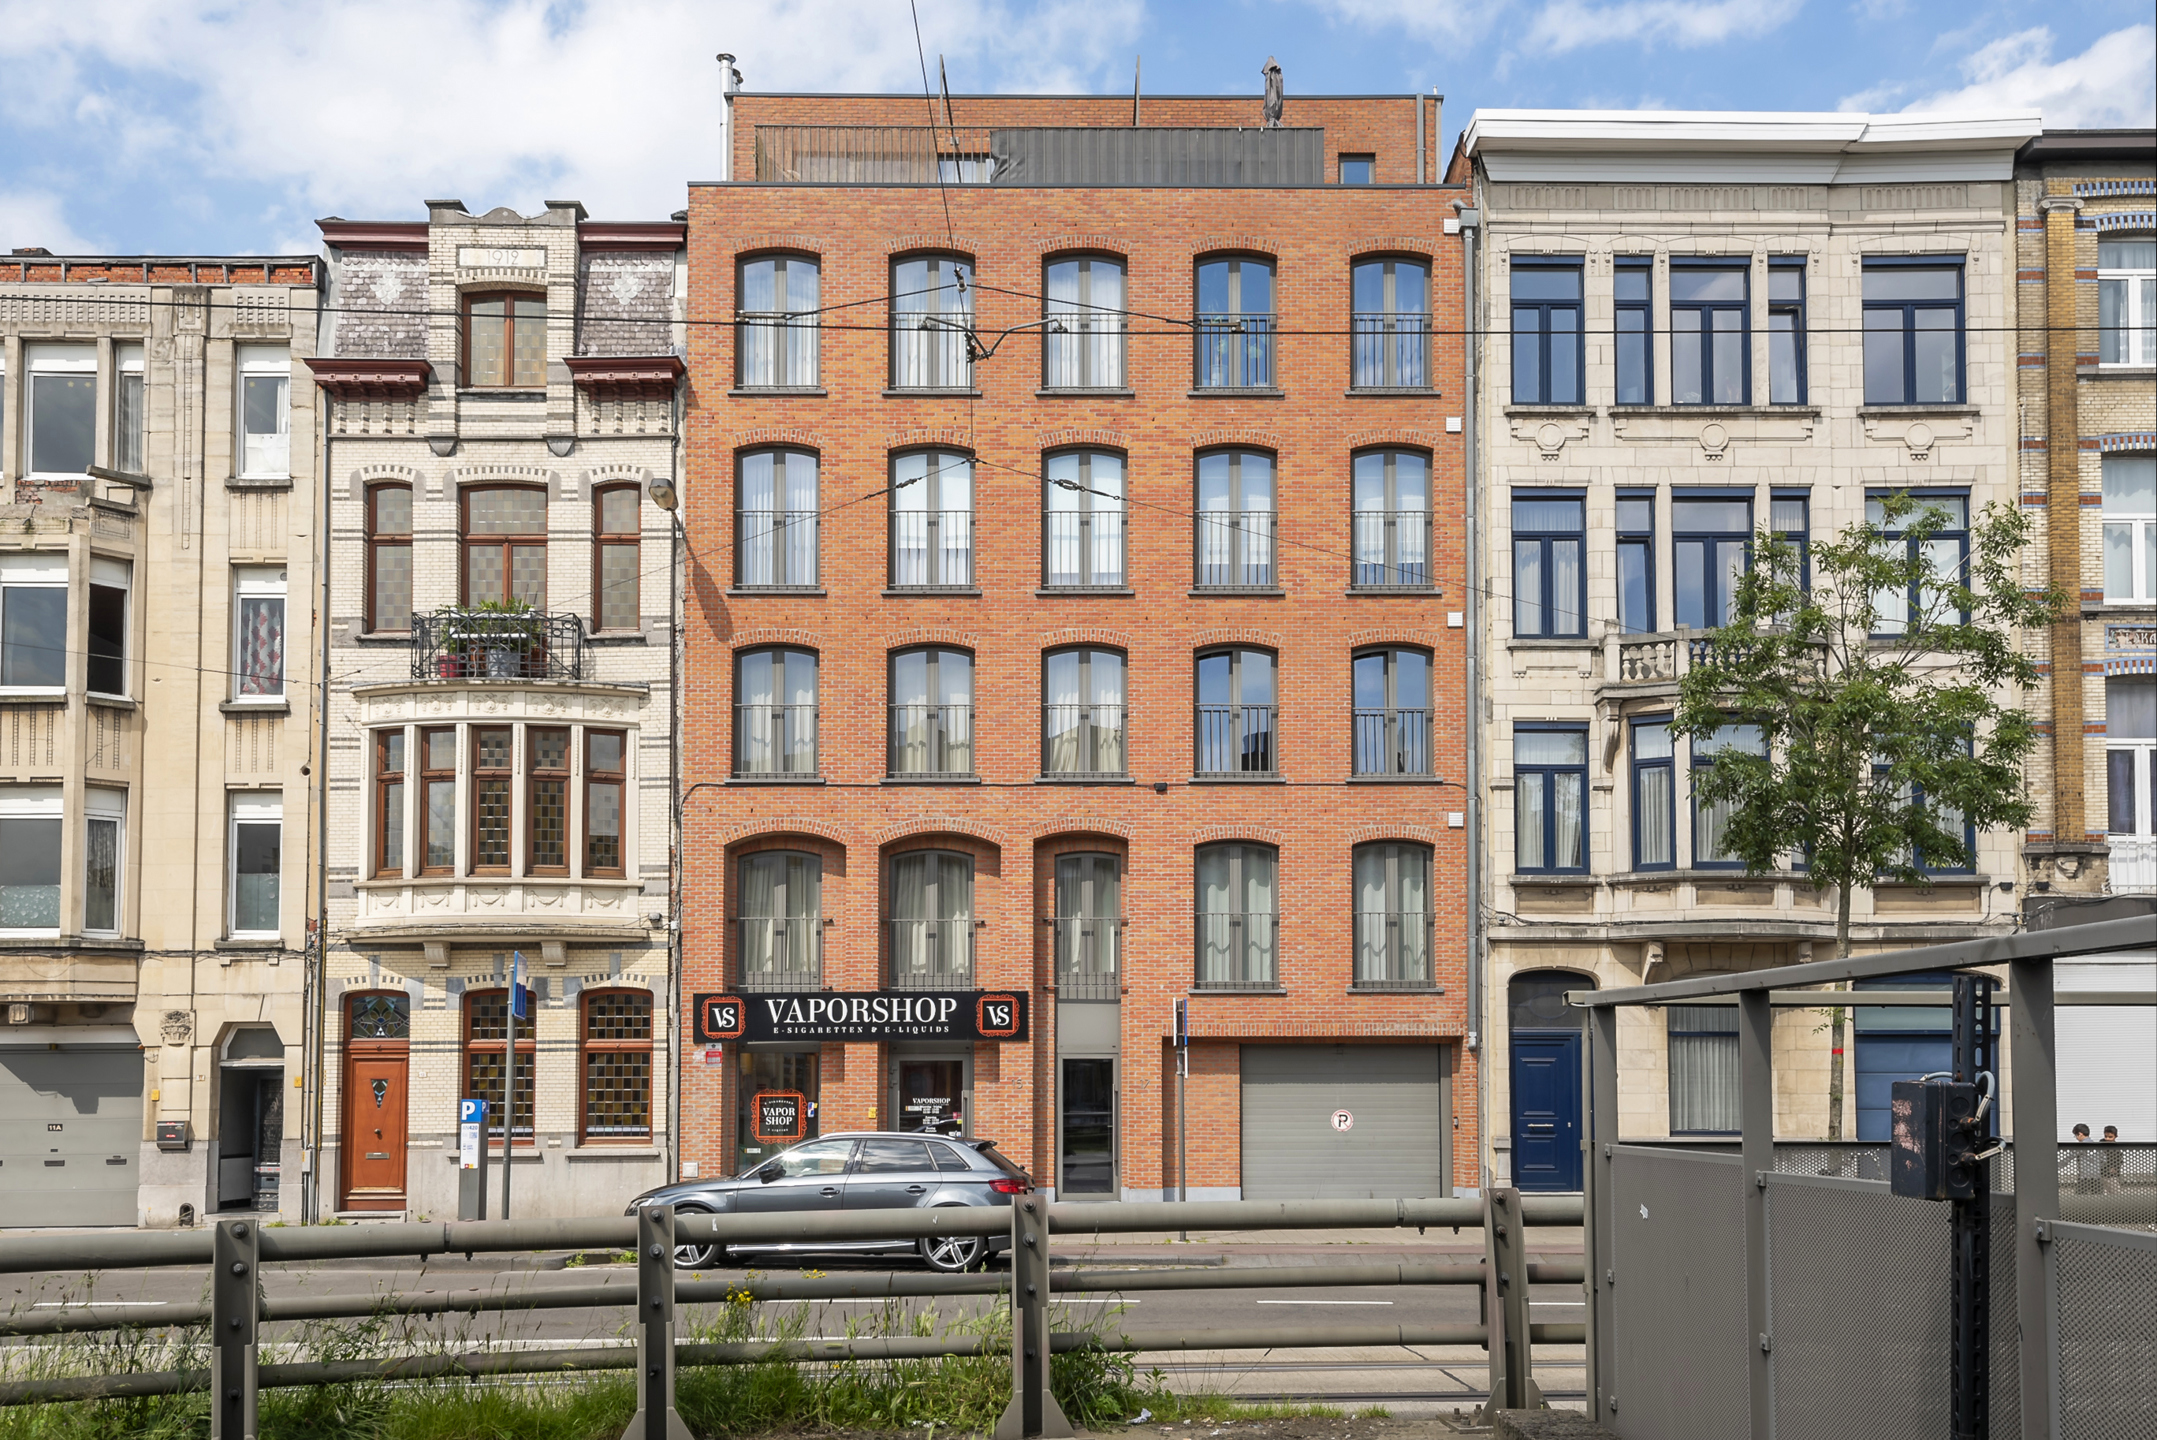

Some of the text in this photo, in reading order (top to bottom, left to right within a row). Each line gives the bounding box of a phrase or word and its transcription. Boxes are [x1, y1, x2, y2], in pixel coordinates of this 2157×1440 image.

[486, 250, 519, 265] 1912
[711, 1007, 736, 1028] VS
[765, 998, 957, 1024] VAPORSHOP
[986, 1005, 1010, 1026] VS
[773, 1026, 863, 1034] E-SIGARETTEN
[884, 1026, 949, 1035] E-LIQUIDS
[1012, 1079, 1023, 1089] 15
[1140, 1079, 1150, 1089] 17
[462, 1101, 476, 1120] P
[763, 1107, 796, 1116] VAPOR
[765, 1116, 793, 1125] SHOP
[1338, 1114, 1349, 1127] P
